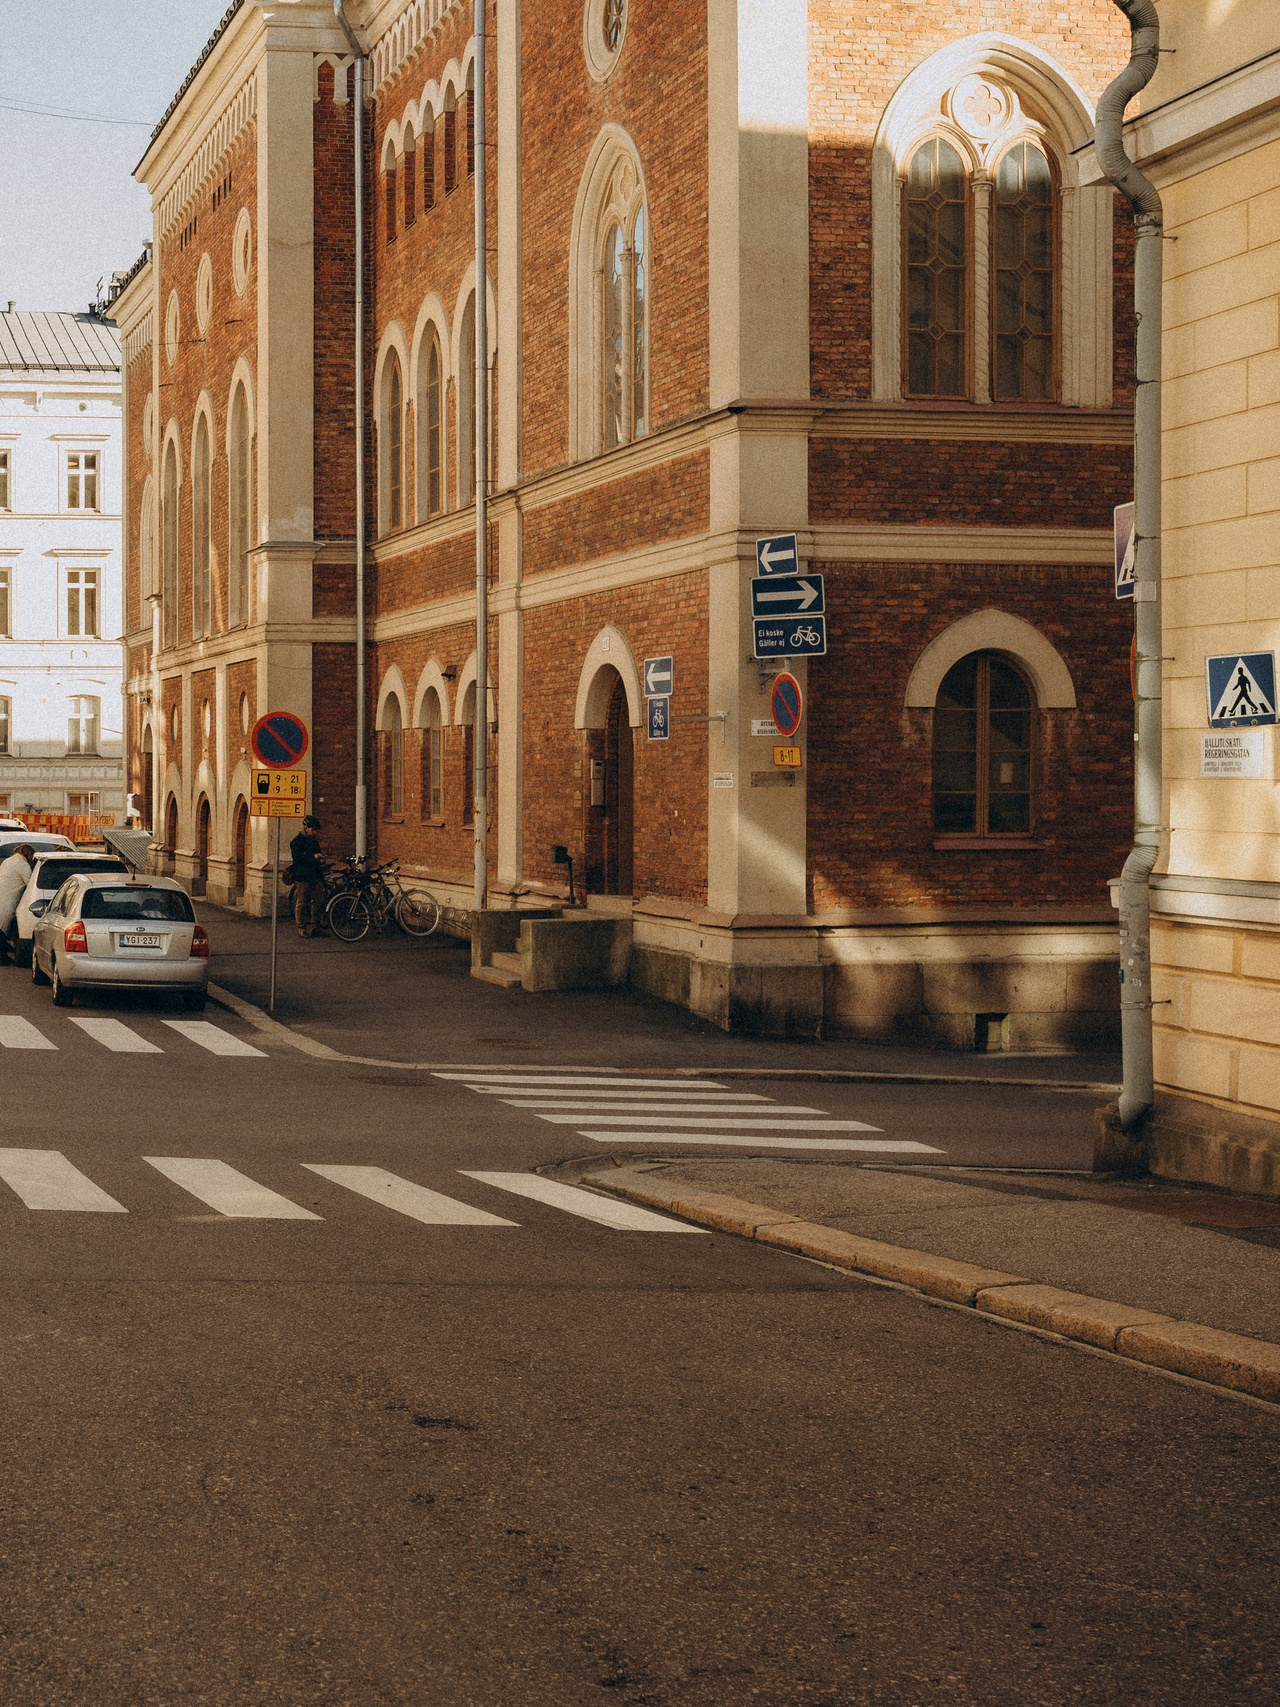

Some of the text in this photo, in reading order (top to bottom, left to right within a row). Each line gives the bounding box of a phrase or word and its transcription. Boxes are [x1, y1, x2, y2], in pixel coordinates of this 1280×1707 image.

[758, 629, 784, 637] Ei koske
[759, 639, 785, 647] Gäller ej
[1204, 738, 1243, 748] HALLITUSKATU
[1204, 748, 1251, 759] REGERINGSGATAN
[291, 775, 299, 783] 21
[294, 803, 301, 814] E
[126, 936, 158, 945] YGI-237
